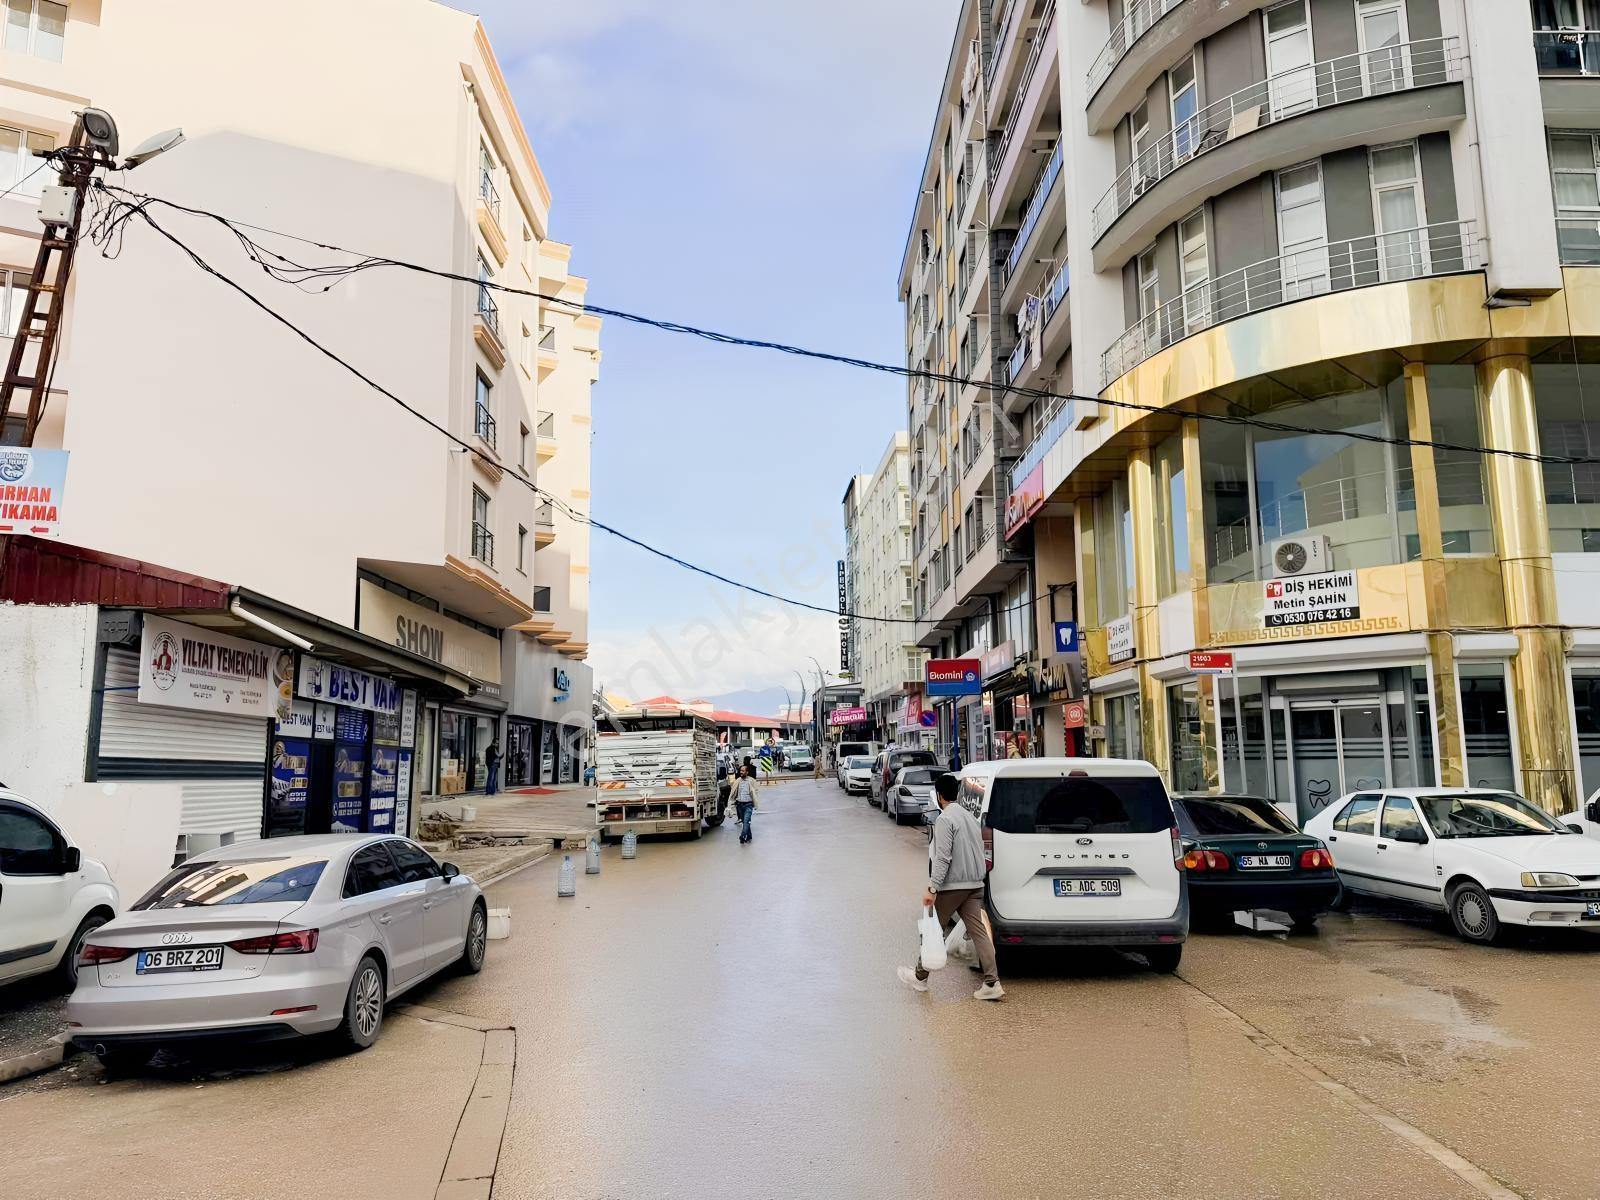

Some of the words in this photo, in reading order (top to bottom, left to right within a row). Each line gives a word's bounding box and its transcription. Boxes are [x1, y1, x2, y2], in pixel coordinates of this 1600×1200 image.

[0, 503, 57, 521] IKAMA
[1285, 580, 1305, 594] DİŞ
[1308, 573, 1353, 591] HEKİMİ
[1274, 598, 1305, 610] Metin
[1308, 591, 1347, 608] ŞAHİN
[1283, 612, 1306, 624] 0530
[1307, 611, 1324, 621] 076
[1326, 609, 1337, 619] 42
[1340, 608, 1352, 618] 16
[395, 614, 444, 664] SHOW
[182, 638, 216, 670] YILTAT
[216, 645, 269, 682] YEMEKÇİLİK
[328, 664, 370, 705] BEST
[372, 678, 399, 711] VAN
[299, 713, 313, 726] VAN
[1242, 856, 1253, 866] 65
[1274, 856, 1290, 866] 400
[1060, 880, 1072, 892] 65
[1079, 880, 1096, 892] ADC
[1101, 880, 1119, 892] 509
[144, 953, 163, 967] 06
[166, 950, 193, 966] BRZ
[195, 949, 221, 964] 201
